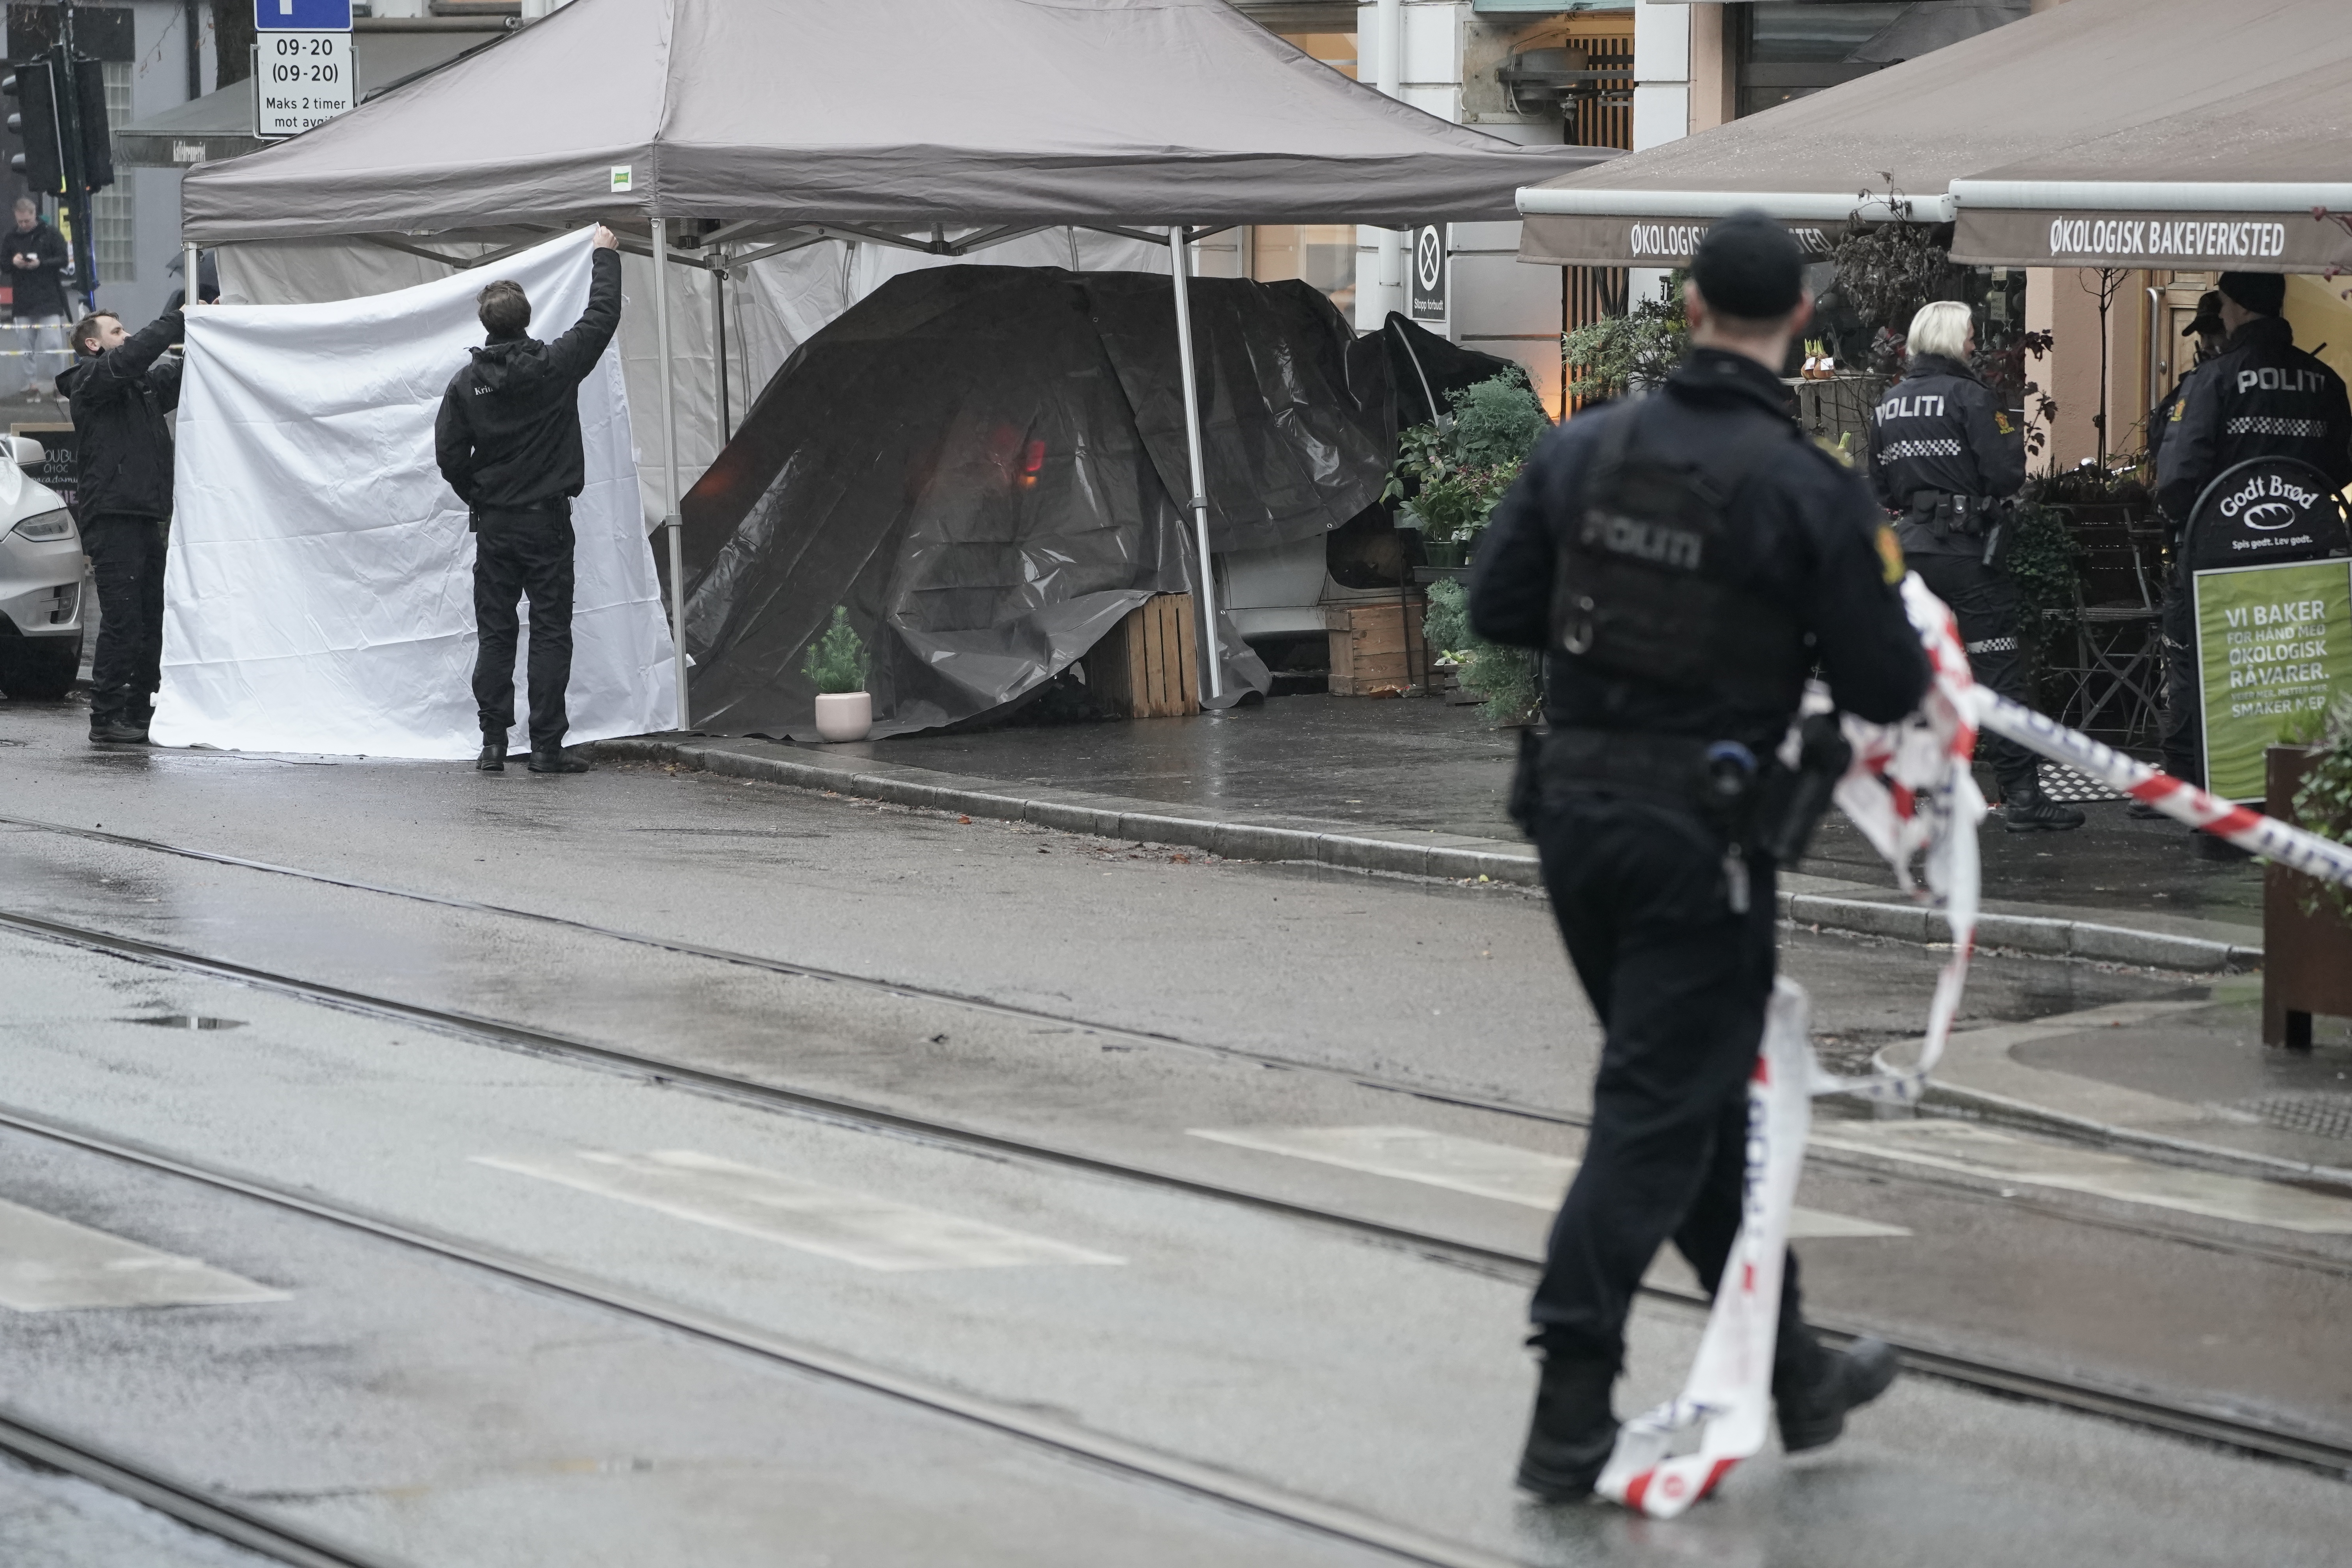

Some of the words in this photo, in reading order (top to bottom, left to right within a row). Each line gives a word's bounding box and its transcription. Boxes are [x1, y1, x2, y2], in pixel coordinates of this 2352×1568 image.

[277, 39, 332, 55] 09-20
[273, 63, 338, 83] (09-20)
[267, 98, 297, 109] Maks
[302, 98, 309, 109] 2
[314, 98, 346, 109] timer
[275, 117, 298, 127] mot
[2049, 216, 2145, 256] ØKOLOGISK
[2148, 221, 2285, 256] BAKEVERKSTED
[1414, 298, 1426, 312] Stopp
[1427, 299, 1443, 310] forbudt
[2237, 367, 2325, 394] POLITI
[1875, 395, 1944, 427] POLITI
[2220, 475, 2266, 517] Godt
[2269, 475, 2319, 510] Brød
[2274, 537, 2290, 545] Lev
[2225, 607, 2248, 628] VI
[2253, 600, 2325, 625] BAKER
[2227, 631, 2252, 645] FOR
[2255, 626, 2295, 642] HÅND
[2298, 624, 2325, 638] MED
[2229, 640, 2328, 666] ØKOLOGISK
[2230, 662, 2330, 688] RÅVARER.
[2232, 700, 2292, 718] SMAKER
